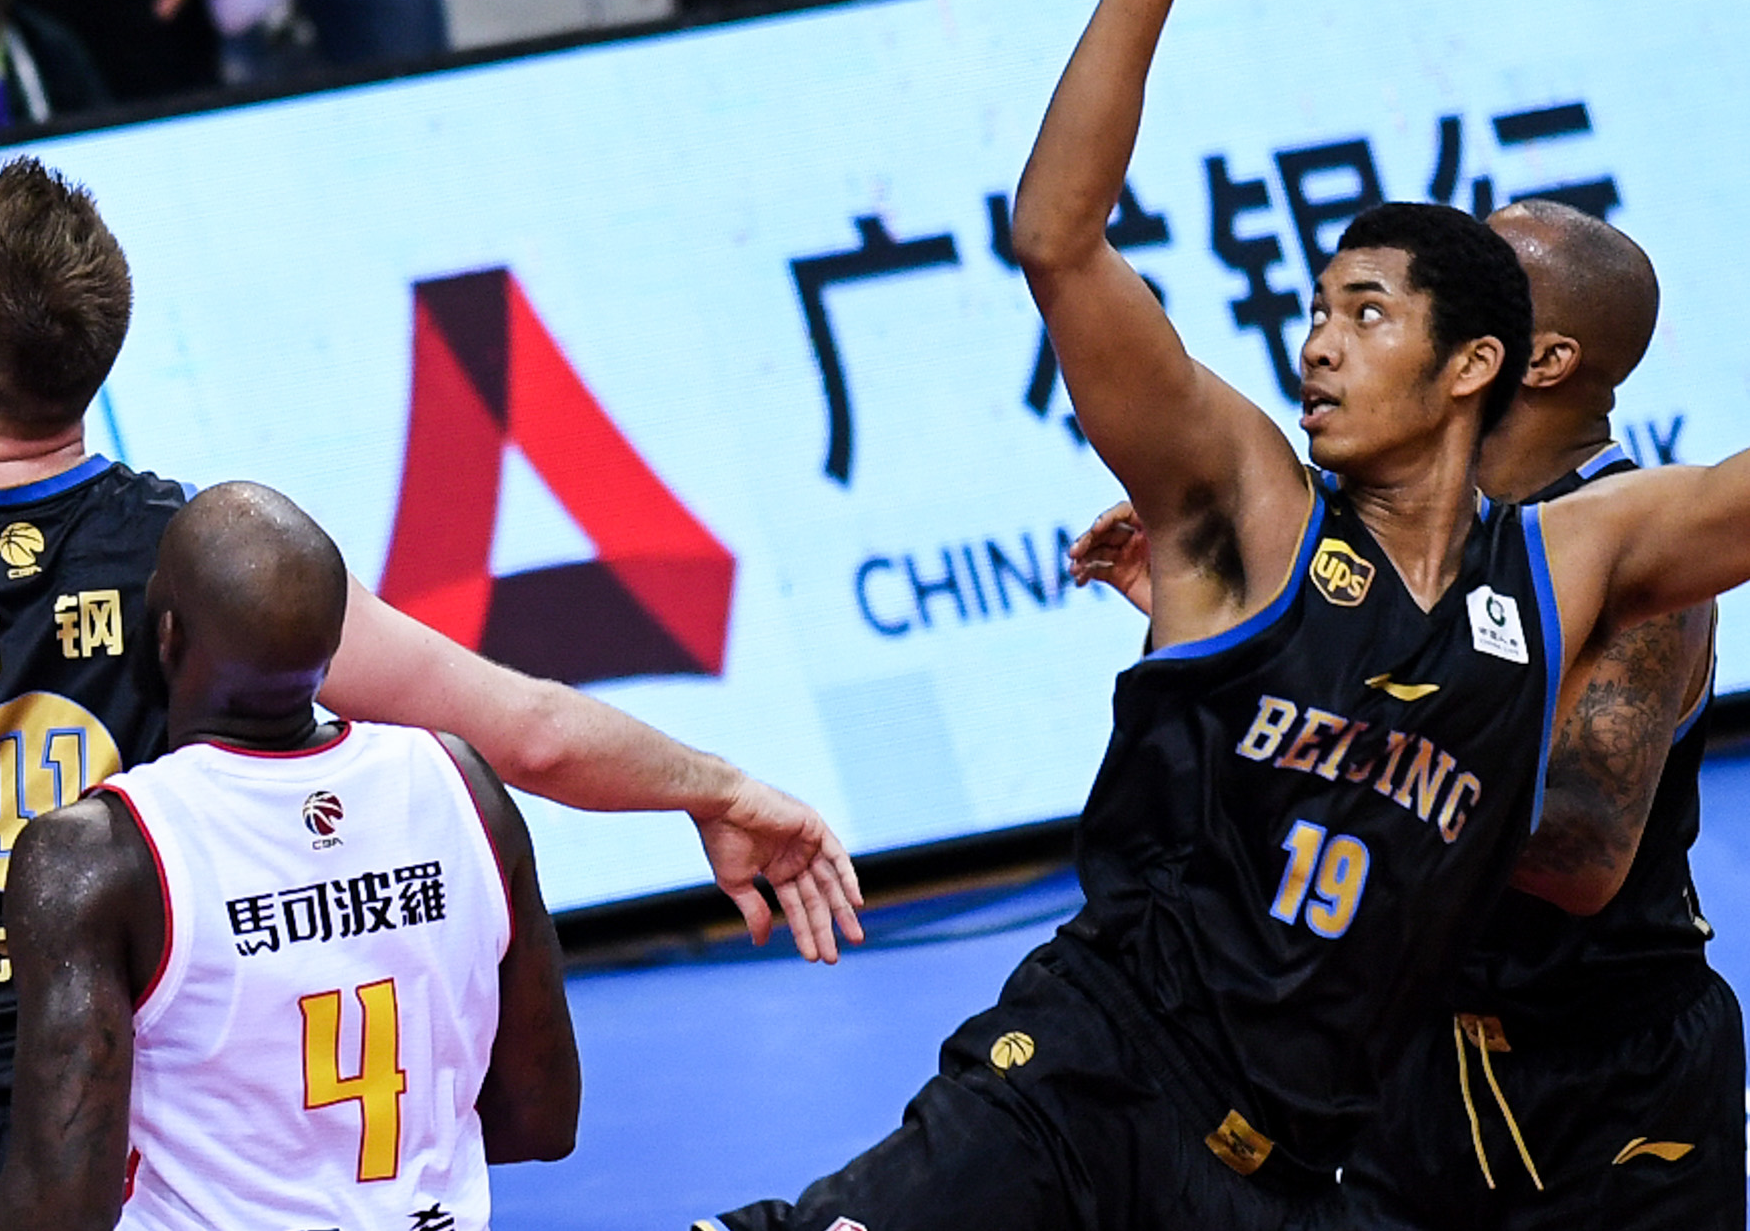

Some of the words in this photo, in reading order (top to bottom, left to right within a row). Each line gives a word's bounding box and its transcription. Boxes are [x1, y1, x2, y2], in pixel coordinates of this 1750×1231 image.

[1317, 554, 1365, 598] ups
[1236, 694, 1482, 844] BEIJING
[312, 837, 344, 850] CBA
[1269, 818, 1371, 940] 19
[225, 860, 447, 957] 馬可波羅
[298, 977, 406, 1183] 4
